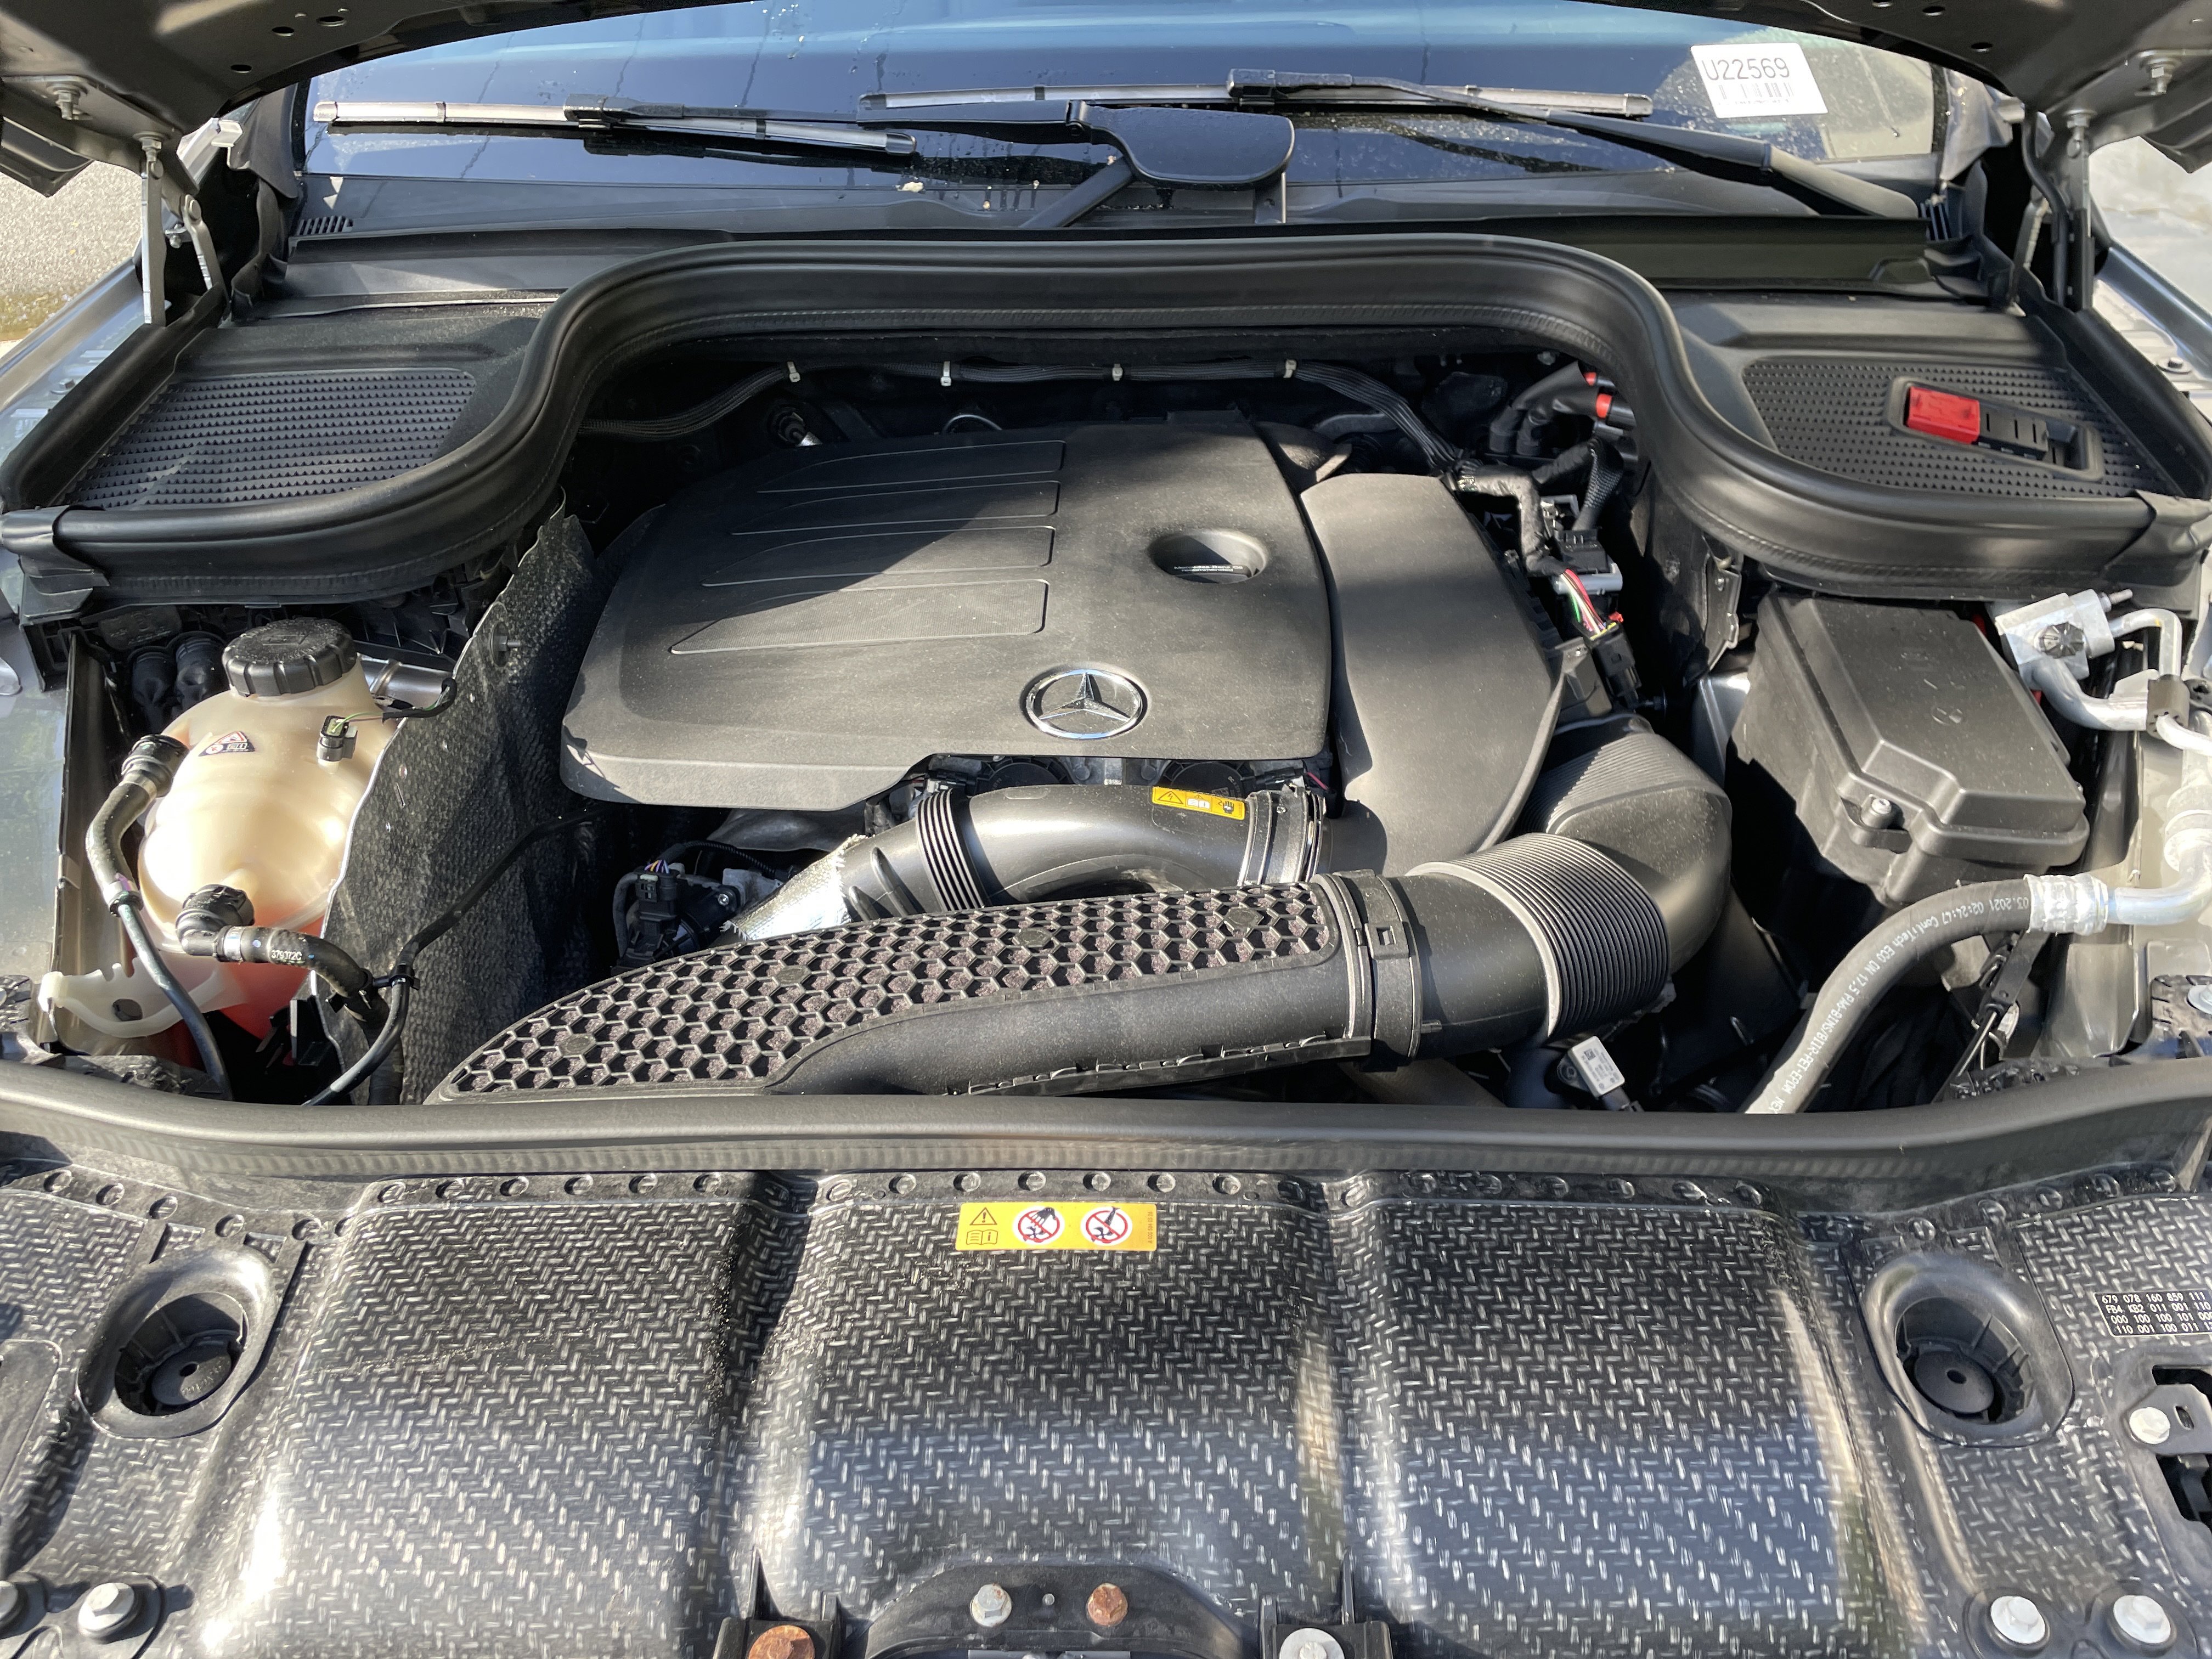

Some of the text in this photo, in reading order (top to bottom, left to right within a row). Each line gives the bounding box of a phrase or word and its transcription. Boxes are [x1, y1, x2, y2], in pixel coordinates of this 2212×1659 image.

[1702, 58, 1790, 81] U22569
[1892, 916, 1939, 948] ContiTech
[1876, 945, 1895, 963] ECO
[2102, 1291, 2205, 1304] 679 078 160 859 111
[2105, 1301, 2211, 1314] FB4 KB2 011 001 110
[2111, 1314, 2129, 1324] 000
[2133, 1314, 2151, 1323] 100
[2155, 1313, 2173, 1323] 100
[2177, 1313, 2194, 1322] 101
[2116, 1325, 2134, 1334] 110
[2137, 1324, 2155, 1334] 001
[2160, 1323, 2178, 1333] 100
[2181, 1322, 2199, 1332] 011
